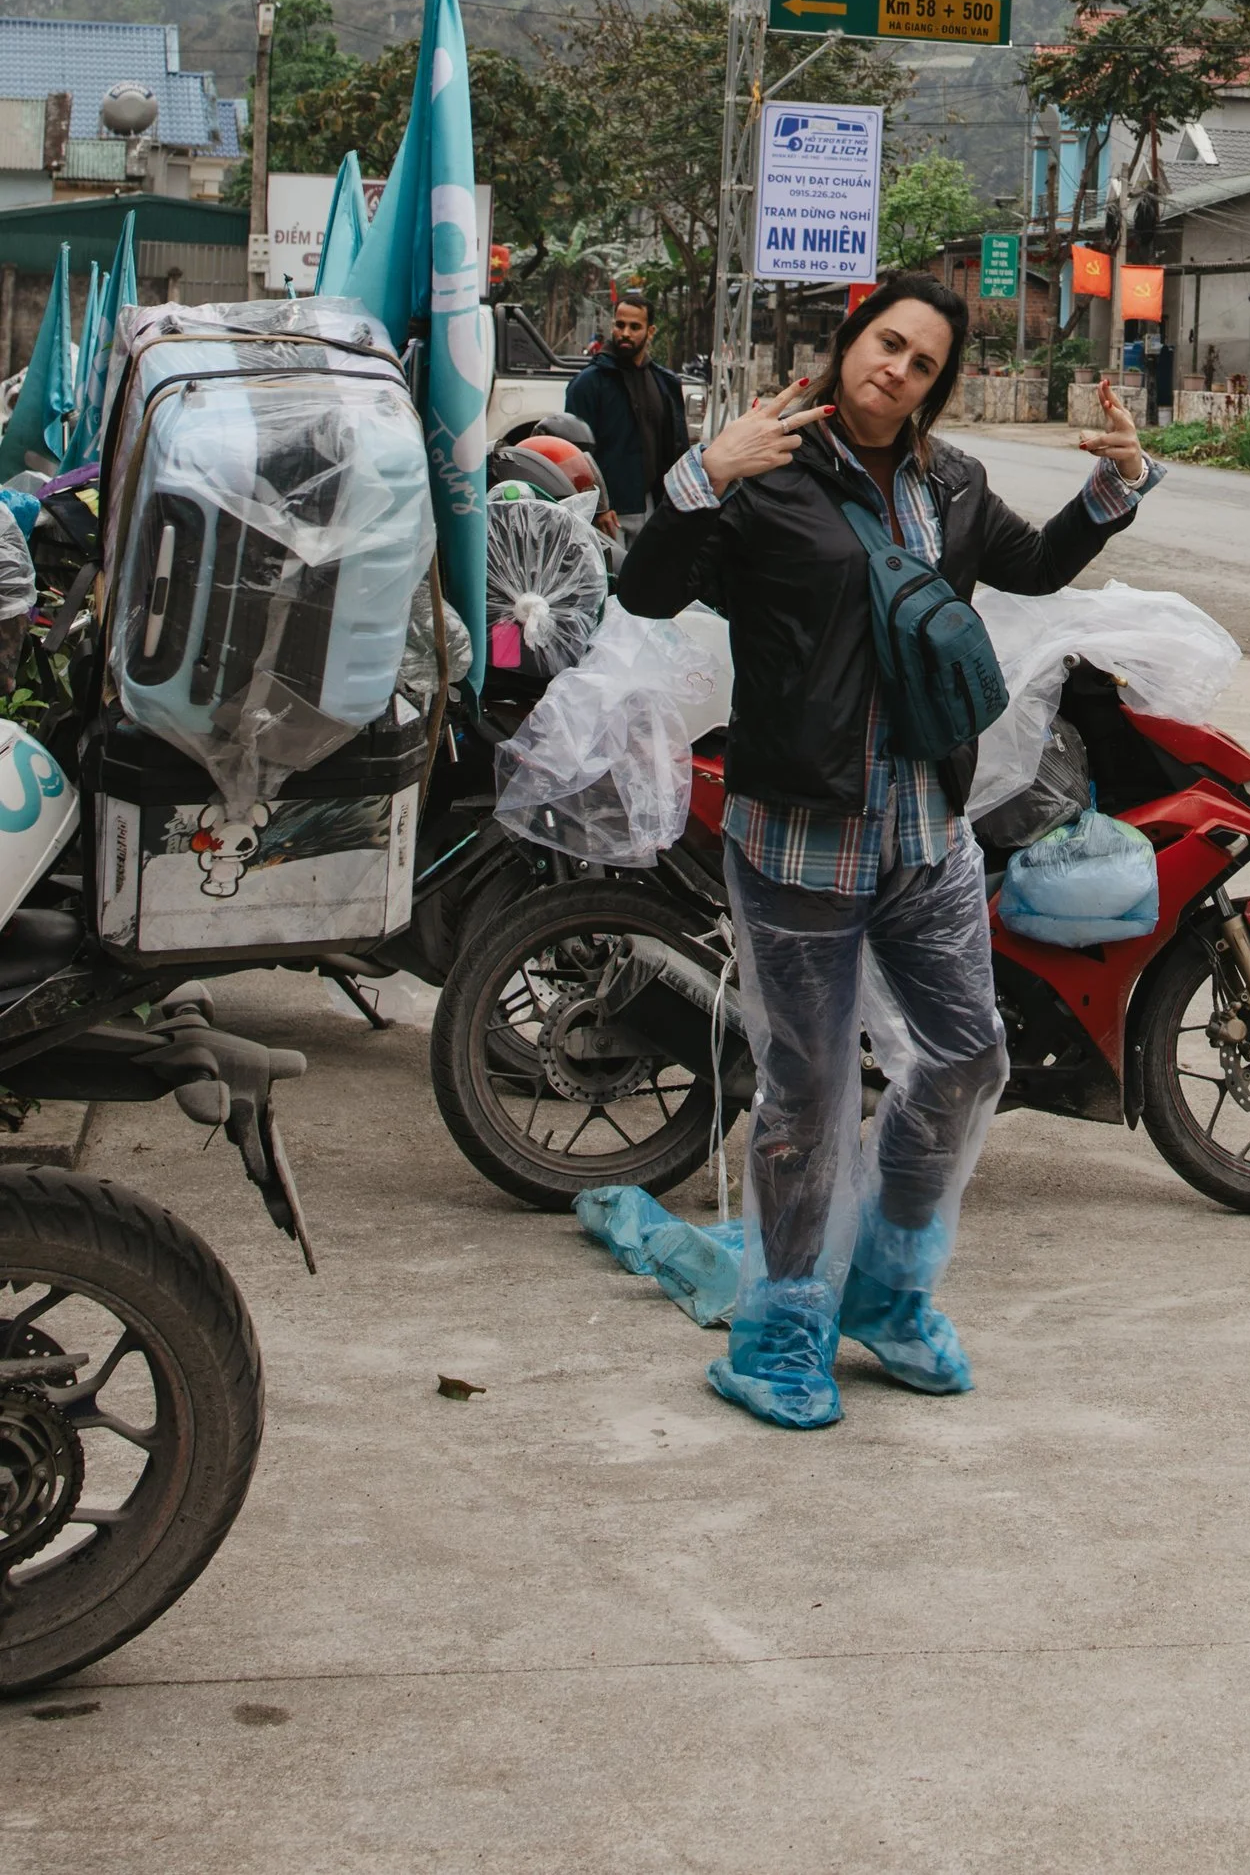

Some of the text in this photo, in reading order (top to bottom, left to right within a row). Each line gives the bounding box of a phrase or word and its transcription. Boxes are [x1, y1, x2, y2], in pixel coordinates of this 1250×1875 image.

[963, 1, 994, 22] 500
[905, 21, 933, 33] GIANG
[804, 144, 827, 154] DU
[767, 174, 792, 184] ĐƠN
[795, 175, 806, 187] VỊ
[809, 176, 830, 188] ĐẠT
[789, 189, 848, 200] 0915.226.204
[764, 206, 871, 222] TRẠM DỪNG NGHỈ
[274, 221, 311, 245] ĐIỂM
[766, 224, 866, 254] AN NHIÊN
[773, 258, 806, 270] Km58
[810, 260, 829, 271] HG
[839, 262, 857, 272] ĐV
[427, 406, 483, 516] Tours
